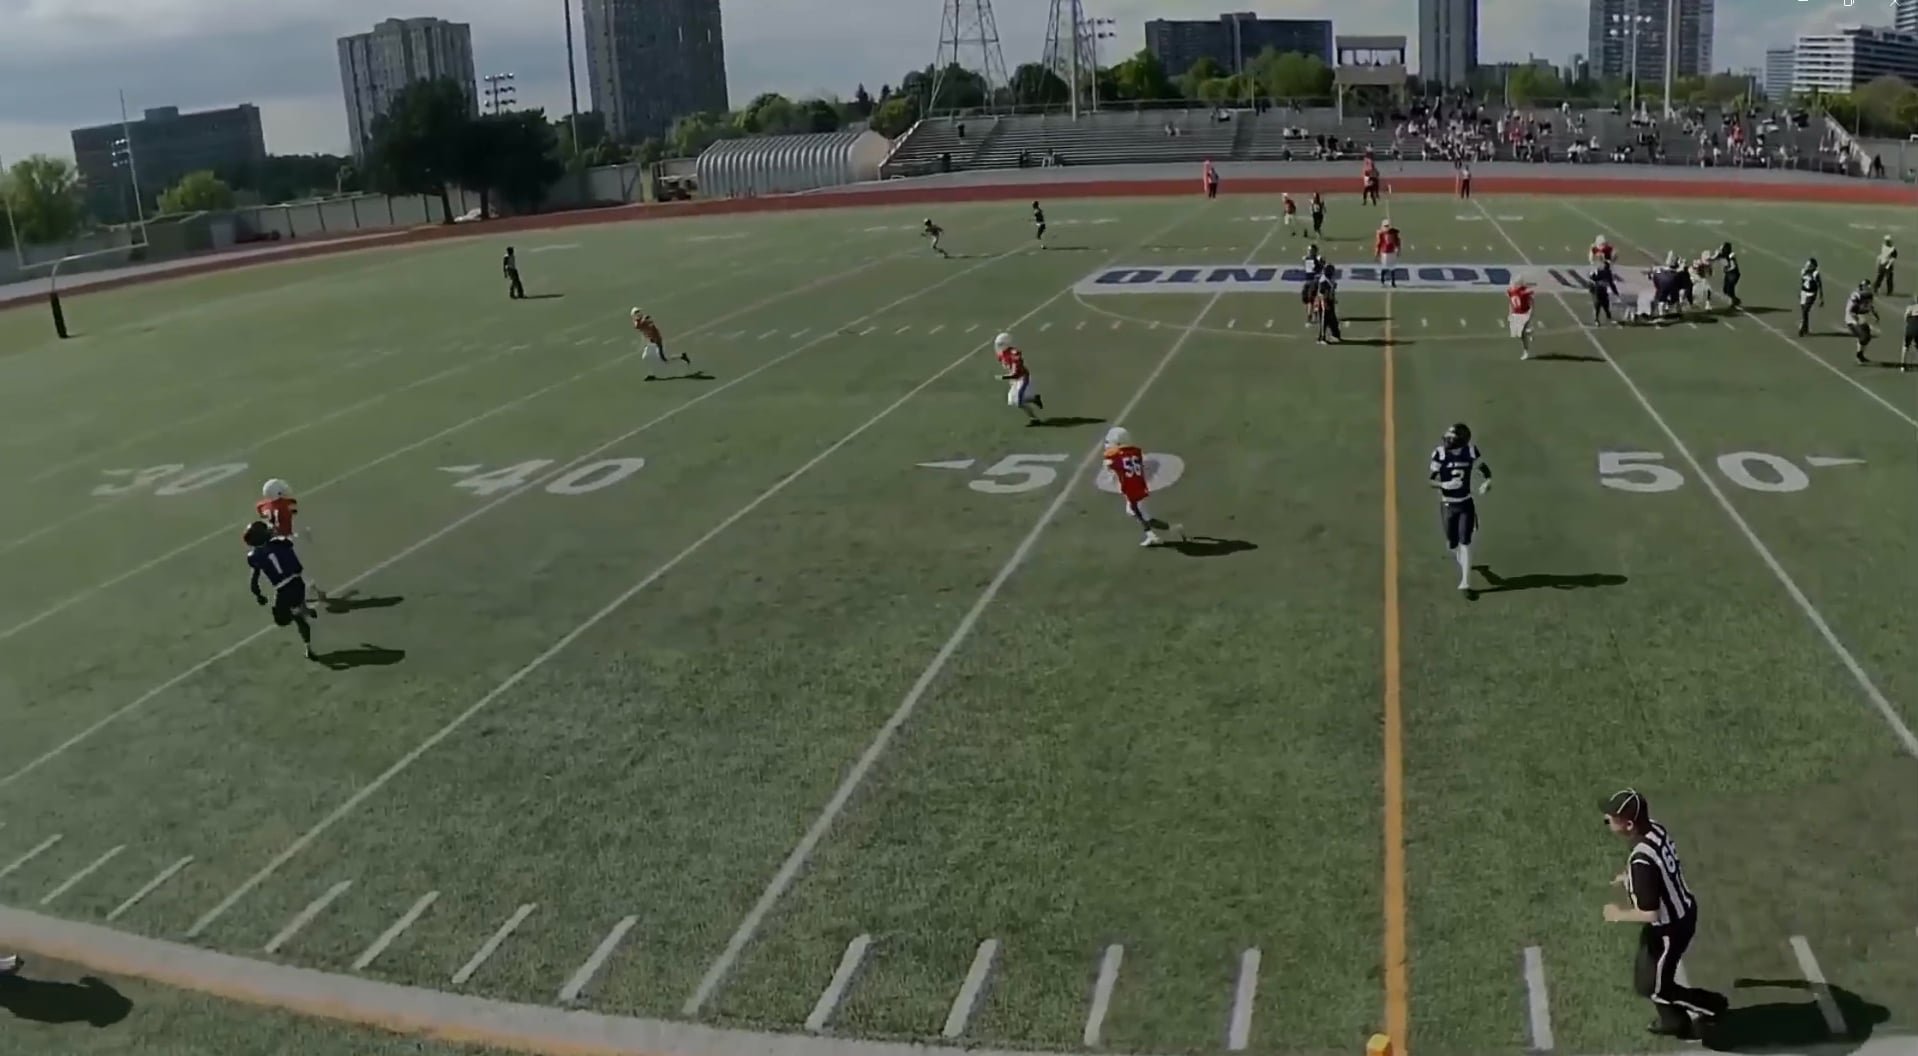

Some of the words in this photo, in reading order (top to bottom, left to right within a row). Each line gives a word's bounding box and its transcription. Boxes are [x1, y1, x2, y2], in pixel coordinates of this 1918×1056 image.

[452, 458, 645, 496] 40
[968, 453, 1185, 494] 50
[1122, 455, 1142, 477] 56
[1598, 452, 1810, 492] 50
[267, 552, 284, 574] 1
